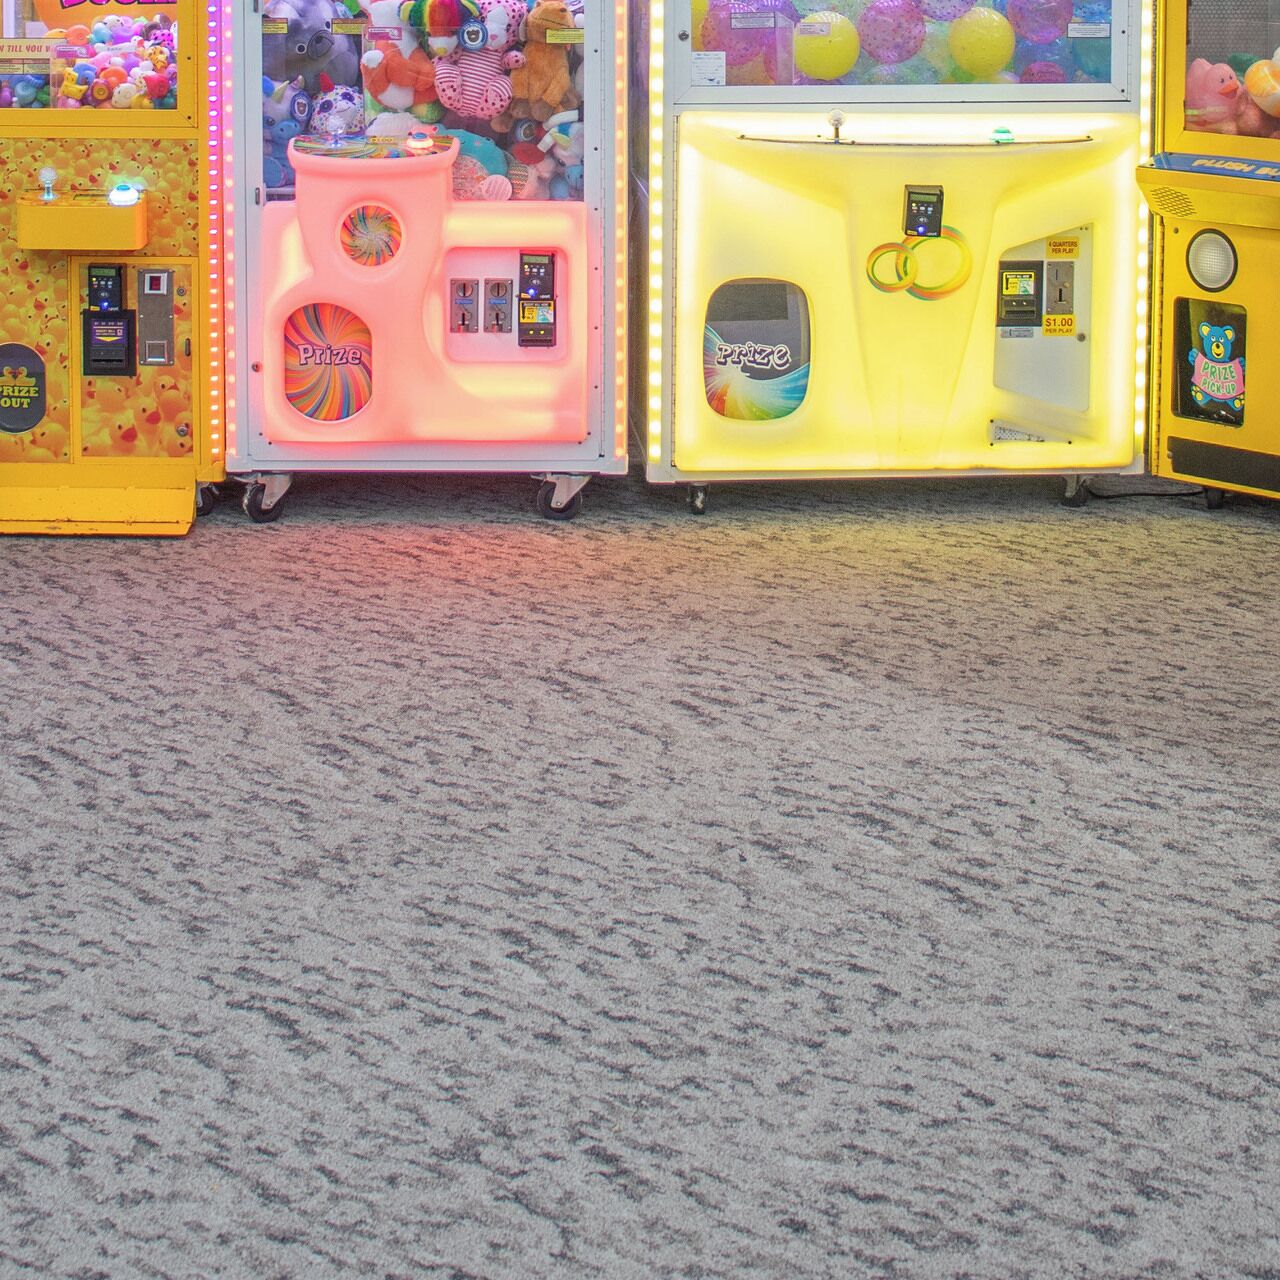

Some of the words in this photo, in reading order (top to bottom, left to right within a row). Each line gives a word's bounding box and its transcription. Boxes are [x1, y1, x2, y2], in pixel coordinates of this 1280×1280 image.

[1192, 159, 1256, 172] PLUSH
[1045, 318, 1073, 326] $1.00
[298, 343, 362, 366] Prize
[715, 342, 792, 370] Prize
[1201, 360, 1236, 381] PRIZE
[0, 397, 30, 408] OUT
